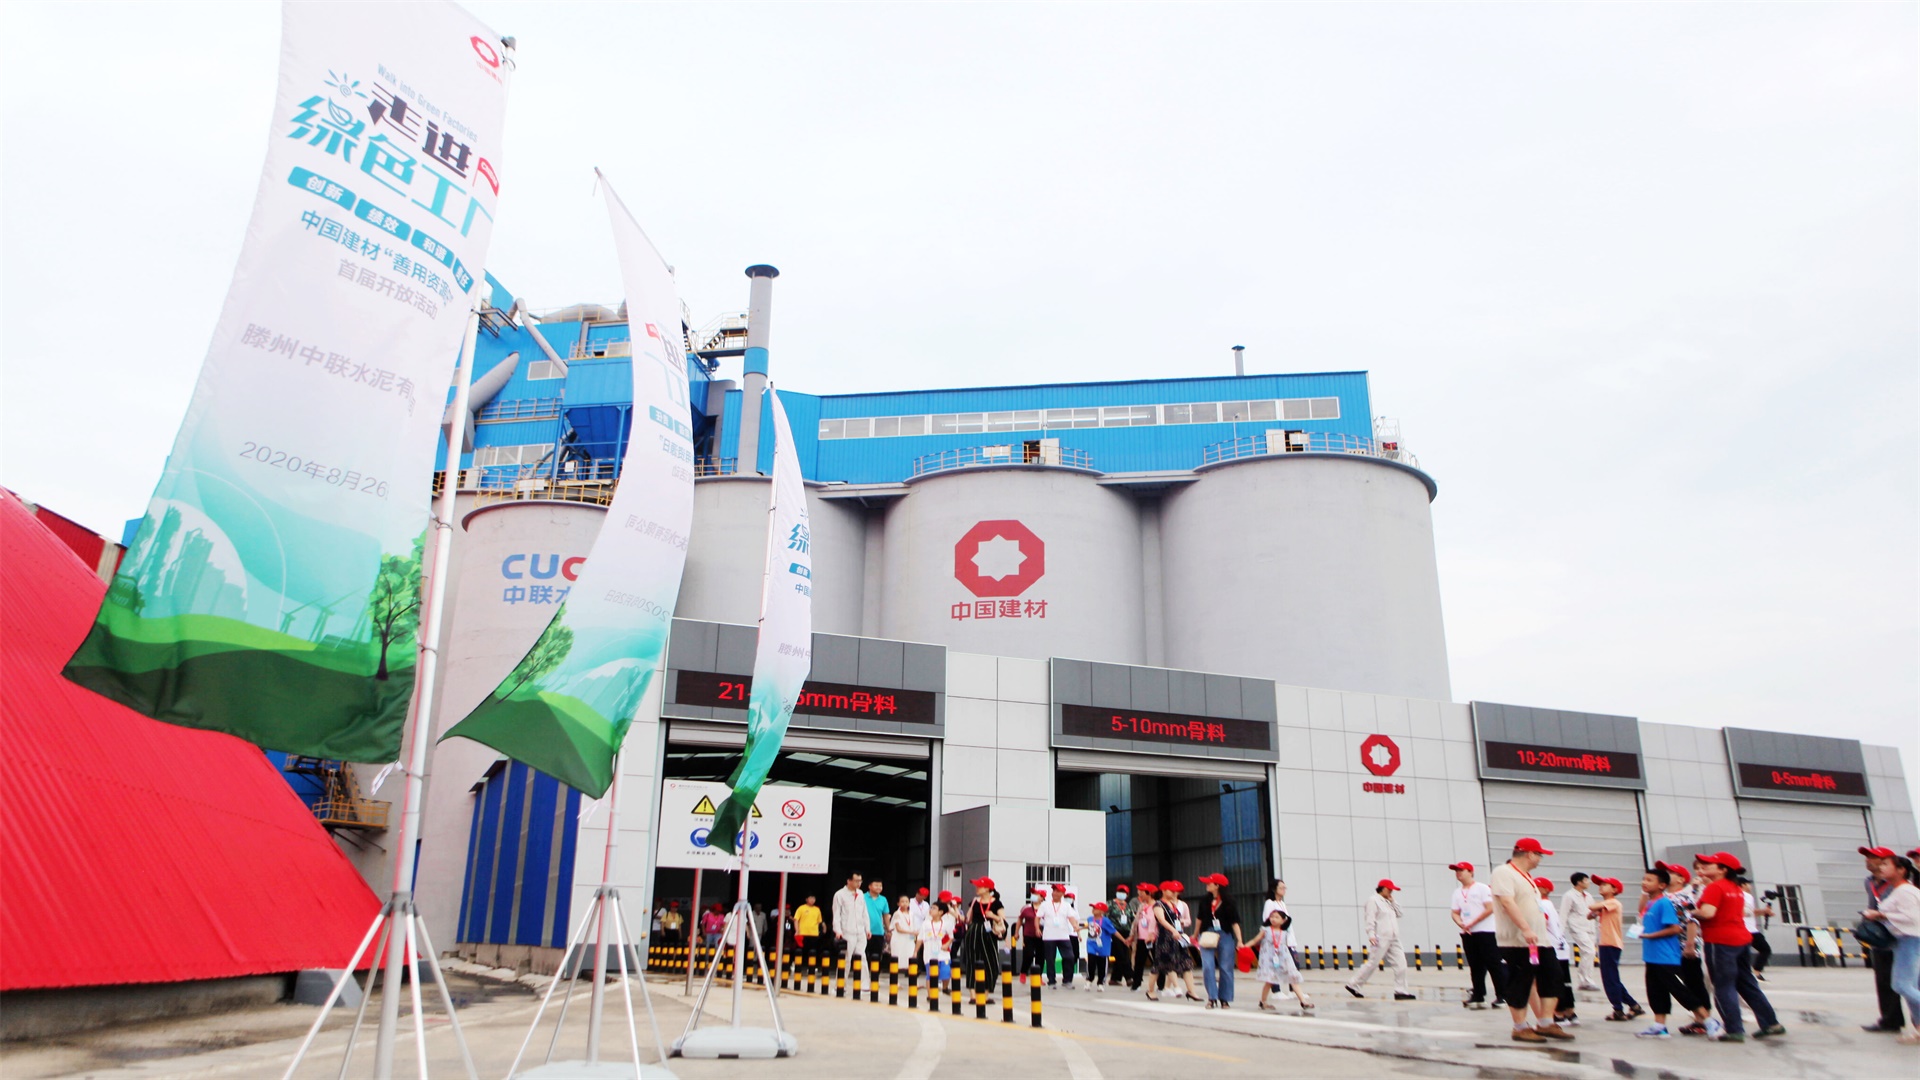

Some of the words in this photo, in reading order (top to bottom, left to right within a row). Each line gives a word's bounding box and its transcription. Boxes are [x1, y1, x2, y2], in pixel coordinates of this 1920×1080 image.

[378, 63, 397, 86] Walk
[400, 80, 416, 100] into
[418, 93, 441, 117] Green
[443, 111, 478, 143] Factories
[367, 82, 473, 179] 走进
[286, 95, 494, 239] 绿色工厂
[306, 175, 344, 203] 创新
[367, 207, 400, 235] 绩效
[337, 258, 439, 320] 首届开放活动
[239, 441, 391, 501] 2020年8月26
[501, 553, 588, 582] CUC
[951, 598, 1048, 621] 中国建材
[1110, 715, 1226, 743] 5-10mm骨料
[1516, 749, 1612, 773] 10-20mm骨料
[786, 835, 796, 849] 5
